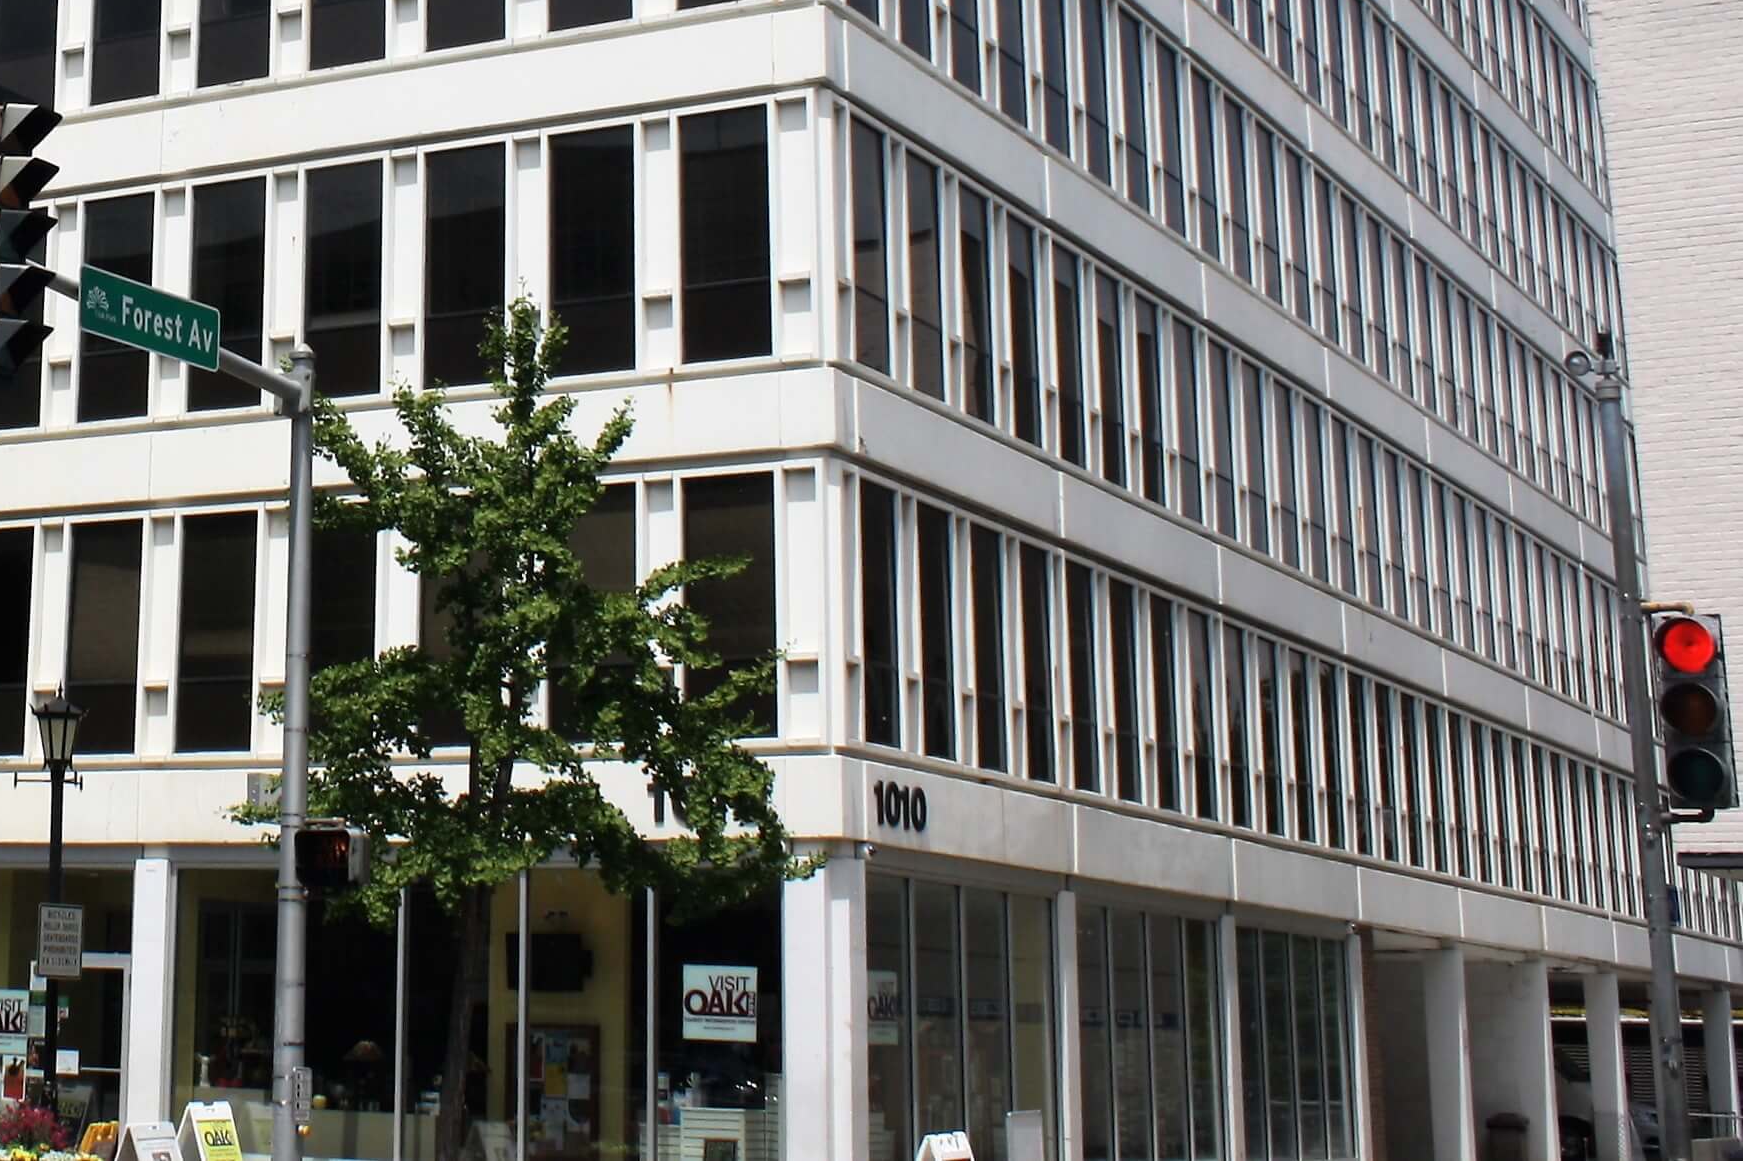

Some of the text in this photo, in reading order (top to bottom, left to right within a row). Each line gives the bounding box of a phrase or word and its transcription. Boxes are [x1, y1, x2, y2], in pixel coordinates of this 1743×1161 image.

[122, 295, 213, 353] Forest Av
[874, 780, 927, 832] 1010
[684, 989, 748, 1016] OAK
[709, 975, 750, 991] VISIT
